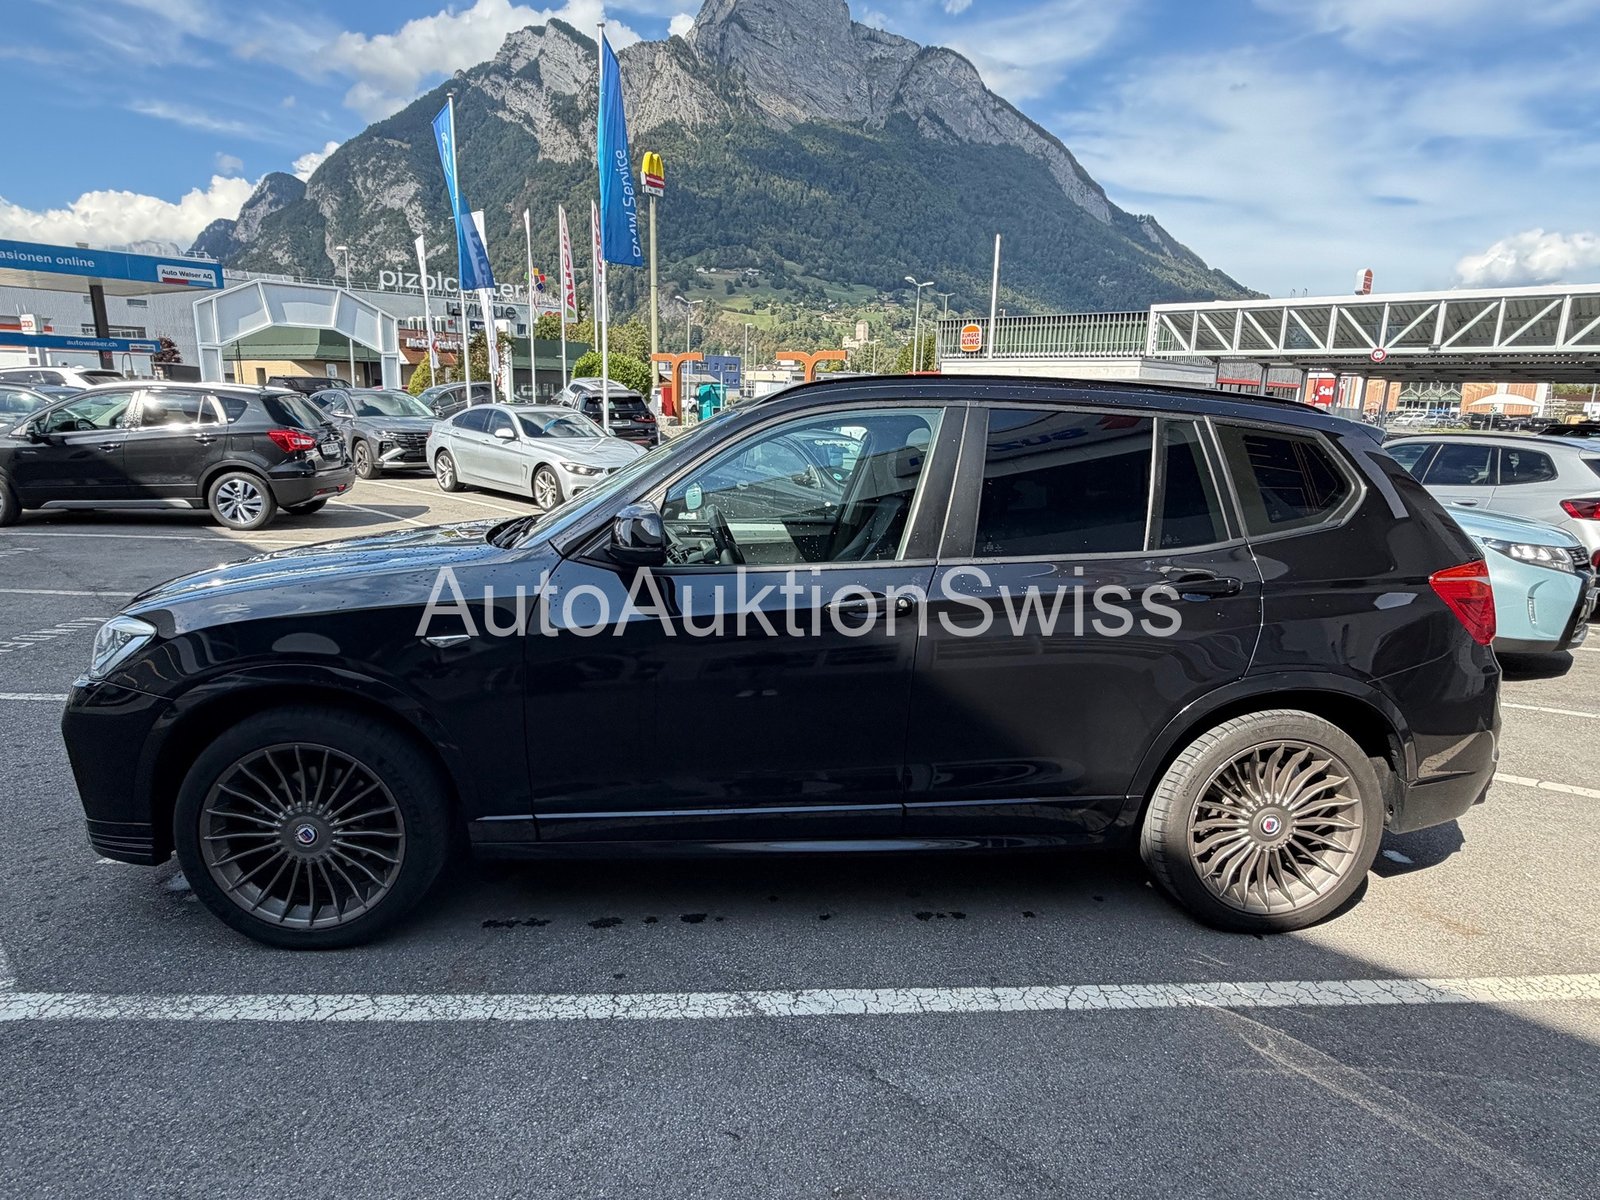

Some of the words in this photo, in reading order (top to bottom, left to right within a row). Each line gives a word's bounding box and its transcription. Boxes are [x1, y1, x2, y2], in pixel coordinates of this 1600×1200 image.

[615, 149, 637, 208] Service
[0, 250, 52, 264] asionen
[56, 256, 95, 268] online
[379, 264, 524, 299] pizolcter
[66, 340, 118, 348] autowalser.ch
[1318, 385, 1334, 396] Sal
